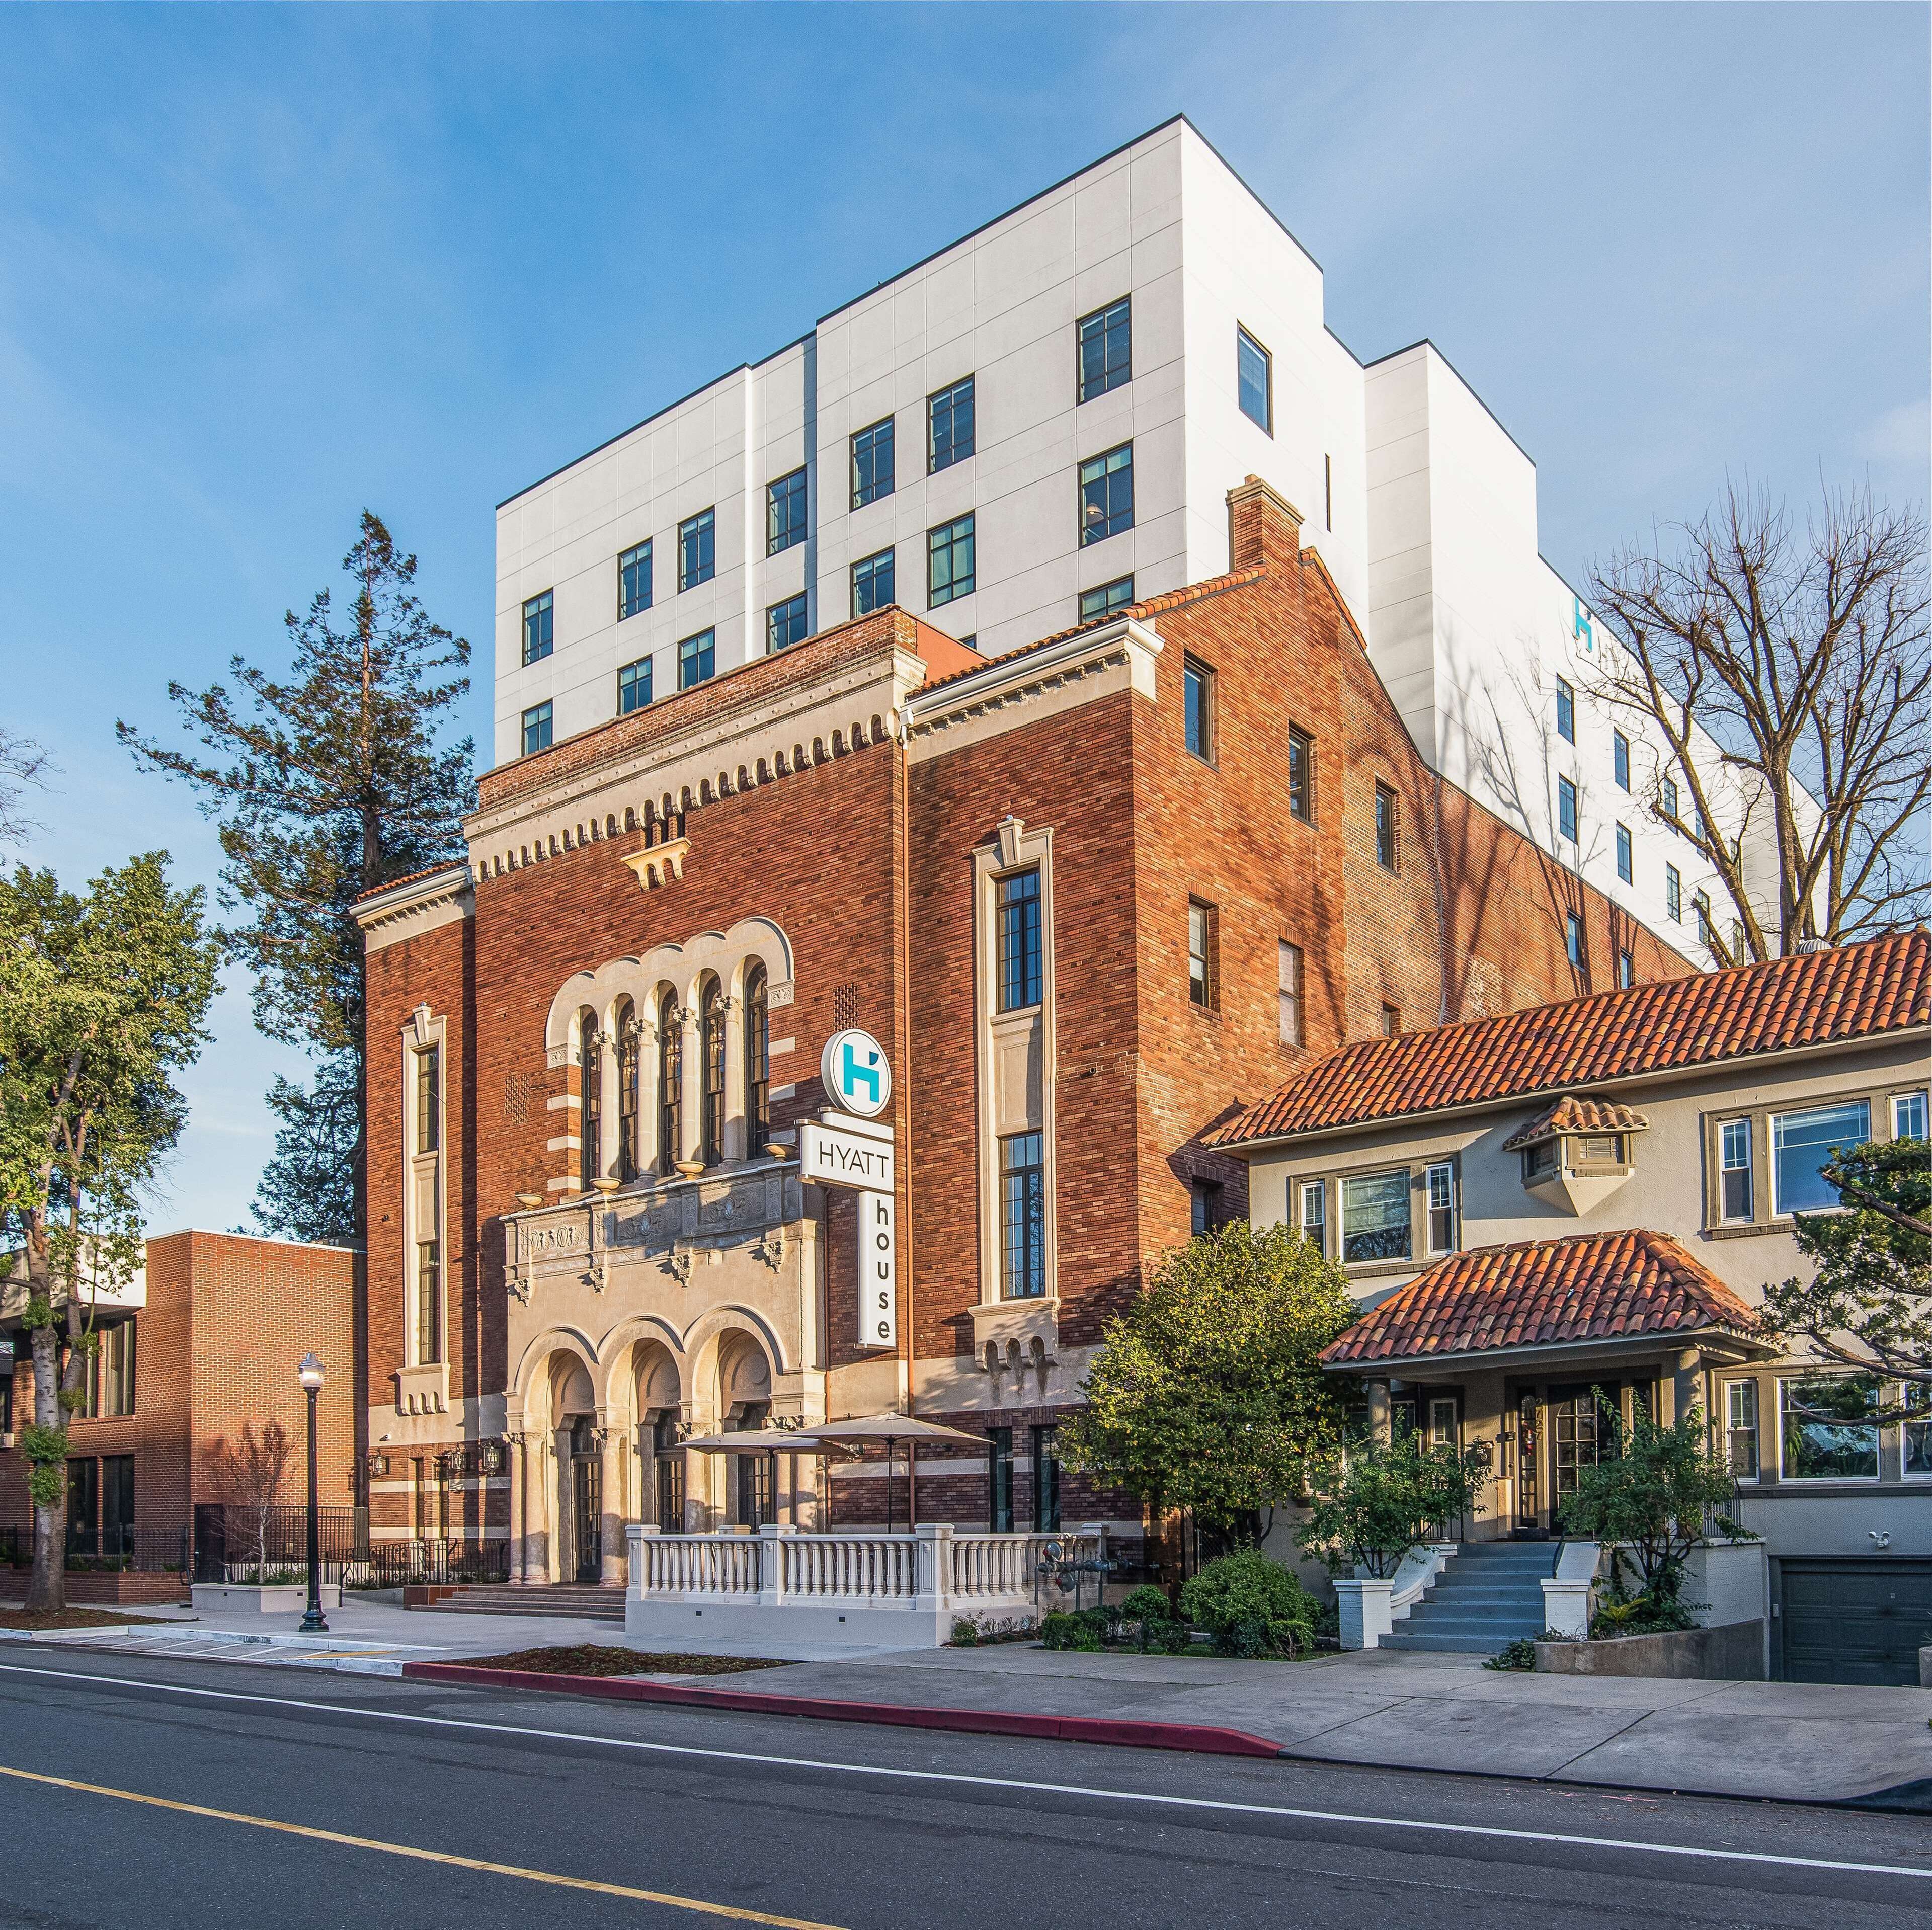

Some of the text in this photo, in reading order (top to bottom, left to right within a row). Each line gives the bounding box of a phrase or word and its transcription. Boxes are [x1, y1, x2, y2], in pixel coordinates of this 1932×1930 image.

[820, 1141, 889, 1178] HYATT
[876, 1199, 890, 1339] house
[1535, 1398, 1544, 1440] 2727
